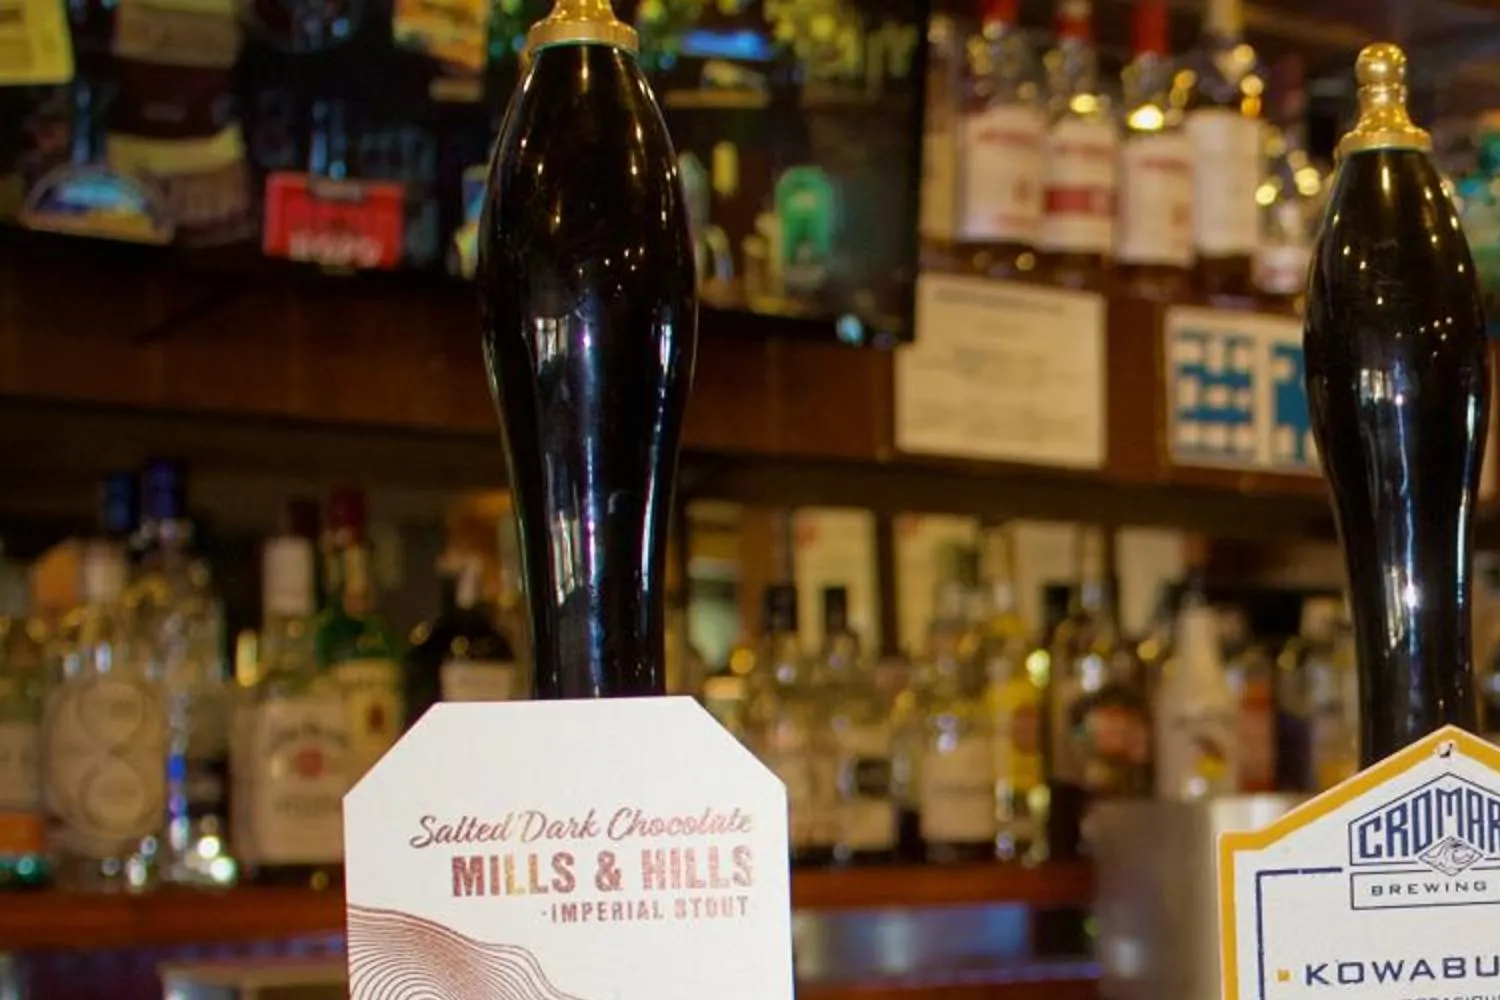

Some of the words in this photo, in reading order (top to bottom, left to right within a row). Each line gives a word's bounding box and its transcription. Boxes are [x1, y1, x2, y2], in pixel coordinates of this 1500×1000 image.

[410, 812, 510, 848] Salted
[518, 809, 599, 842] Dark
[608, 807, 753, 841] Chocolate
[451, 852, 576, 896] MILLS
[595, 850, 623, 891] &
[641, 845, 755, 890] HILLS
[1371, 880, 1487, 897] BREWING
[551, 900, 664, 923] IMPERIAL
[674, 896, 748, 919] STOUT
